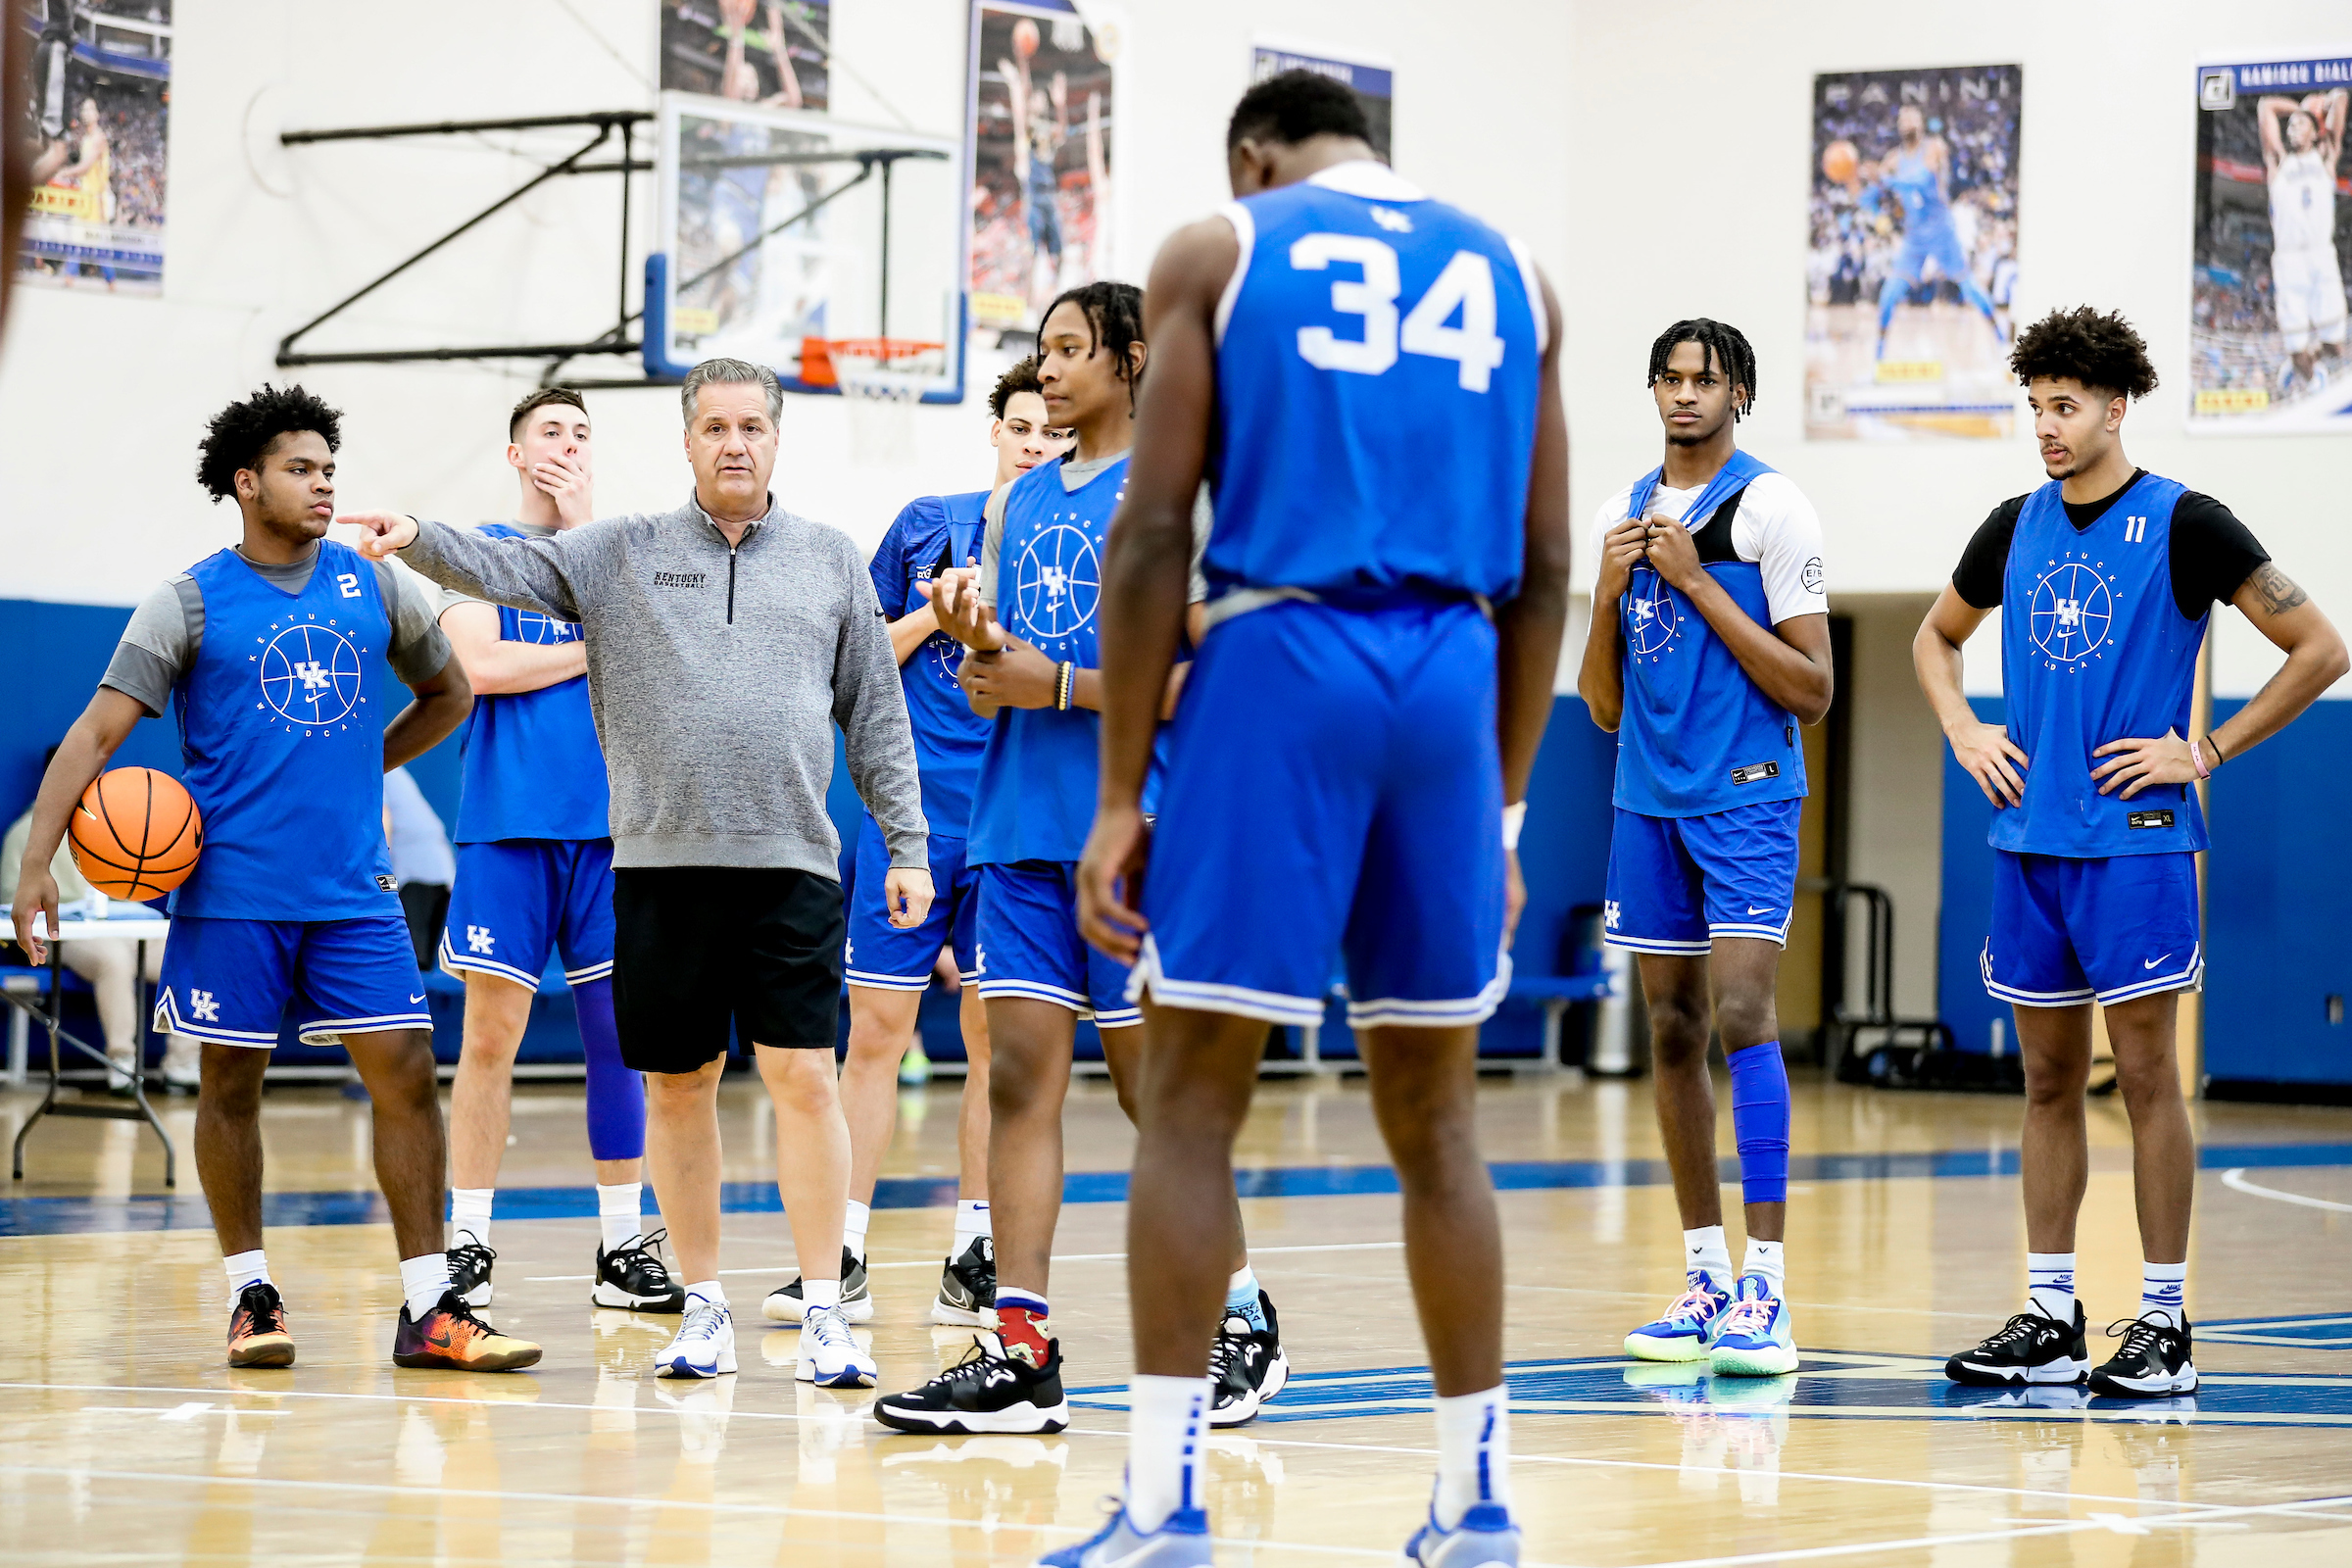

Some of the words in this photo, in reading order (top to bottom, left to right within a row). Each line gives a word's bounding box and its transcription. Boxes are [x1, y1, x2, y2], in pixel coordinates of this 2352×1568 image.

[1825, 75, 2010, 107] PANINI
[1289, 231, 1506, 394] 34
[1012, 512, 1104, 568] KENTUCK
[2124, 515, 2147, 543] 11
[336, 572, 363, 599] 2
[655, 571, 707, 583] KENTUCKY
[1042, 565, 1068, 597] UK
[2026, 551, 2124, 597] KENTUCKY
[2056, 598, 2081, 627] UK
[248, 612, 368, 663] KENTUCKY
[294, 661, 331, 690] UK
[256, 696, 367, 738] WILDCATS
[466, 924, 496, 956] UK
[190, 988, 220, 1022] UK
